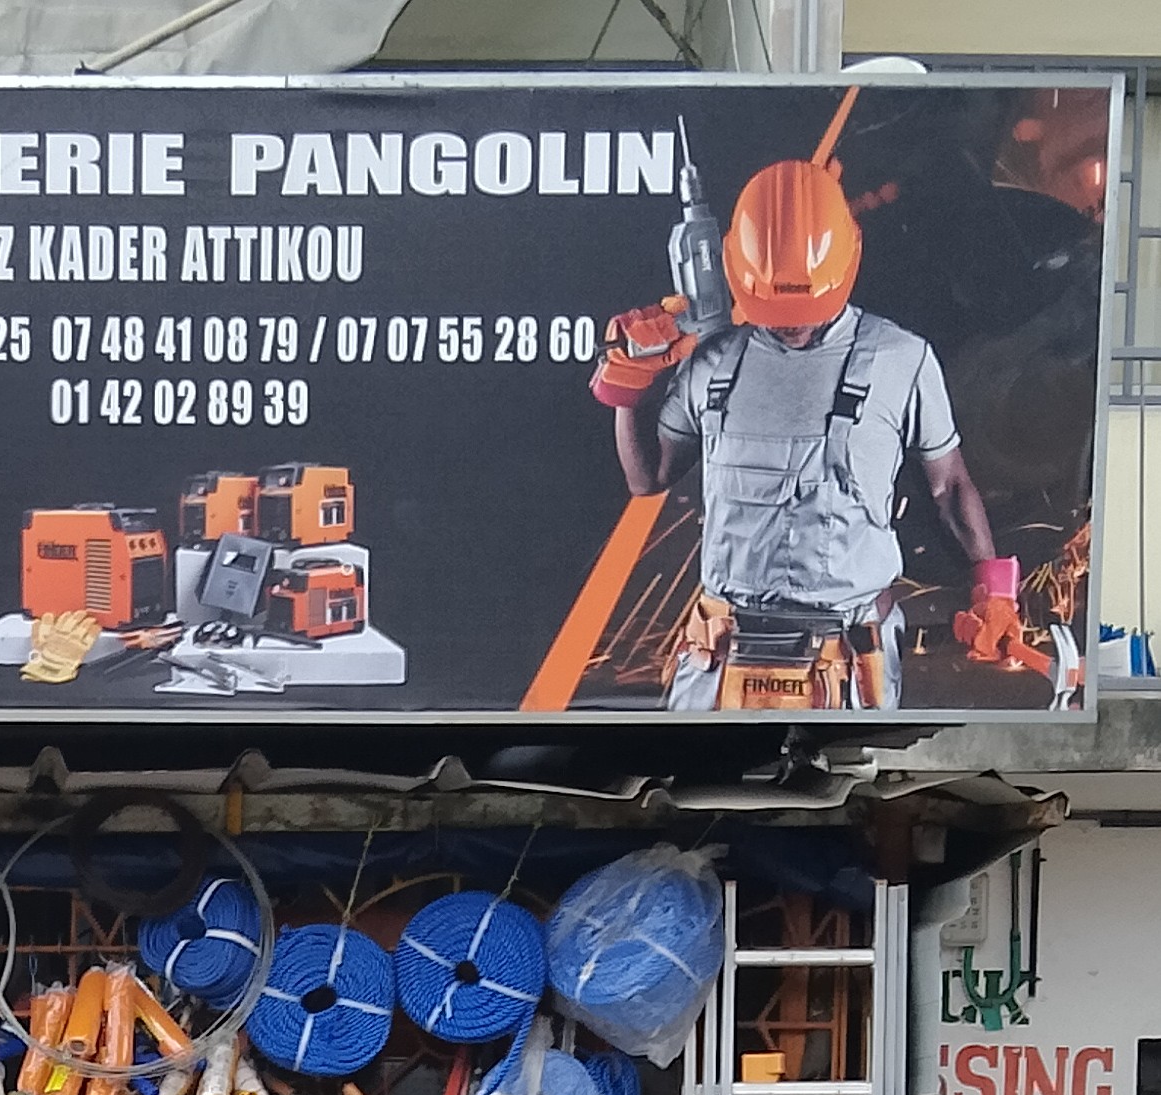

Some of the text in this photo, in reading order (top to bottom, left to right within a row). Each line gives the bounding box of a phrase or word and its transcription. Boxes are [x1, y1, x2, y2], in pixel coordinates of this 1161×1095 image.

[230, 131, 676, 196] PANGOLIN
[28, 224, 167, 282] KADER
[179, 224, 364, 283] ATTIKOU
[51, 316, 92, 362] 07
[100, 316, 144, 362] 48
[154, 316, 193, 362] 41
[204, 316, 249, 362] 08
[258, 316, 299, 362] 79
[308, 316, 328, 362] /
[337, 316, 378, 362] 07
[387, 316, 429, 362] 07
[438, 316, 484, 362] 55
[494, 316, 538, 362] 28
[548, 316, 595, 362] 60
[50, 379, 310, 426] 01 42 02 89 39
